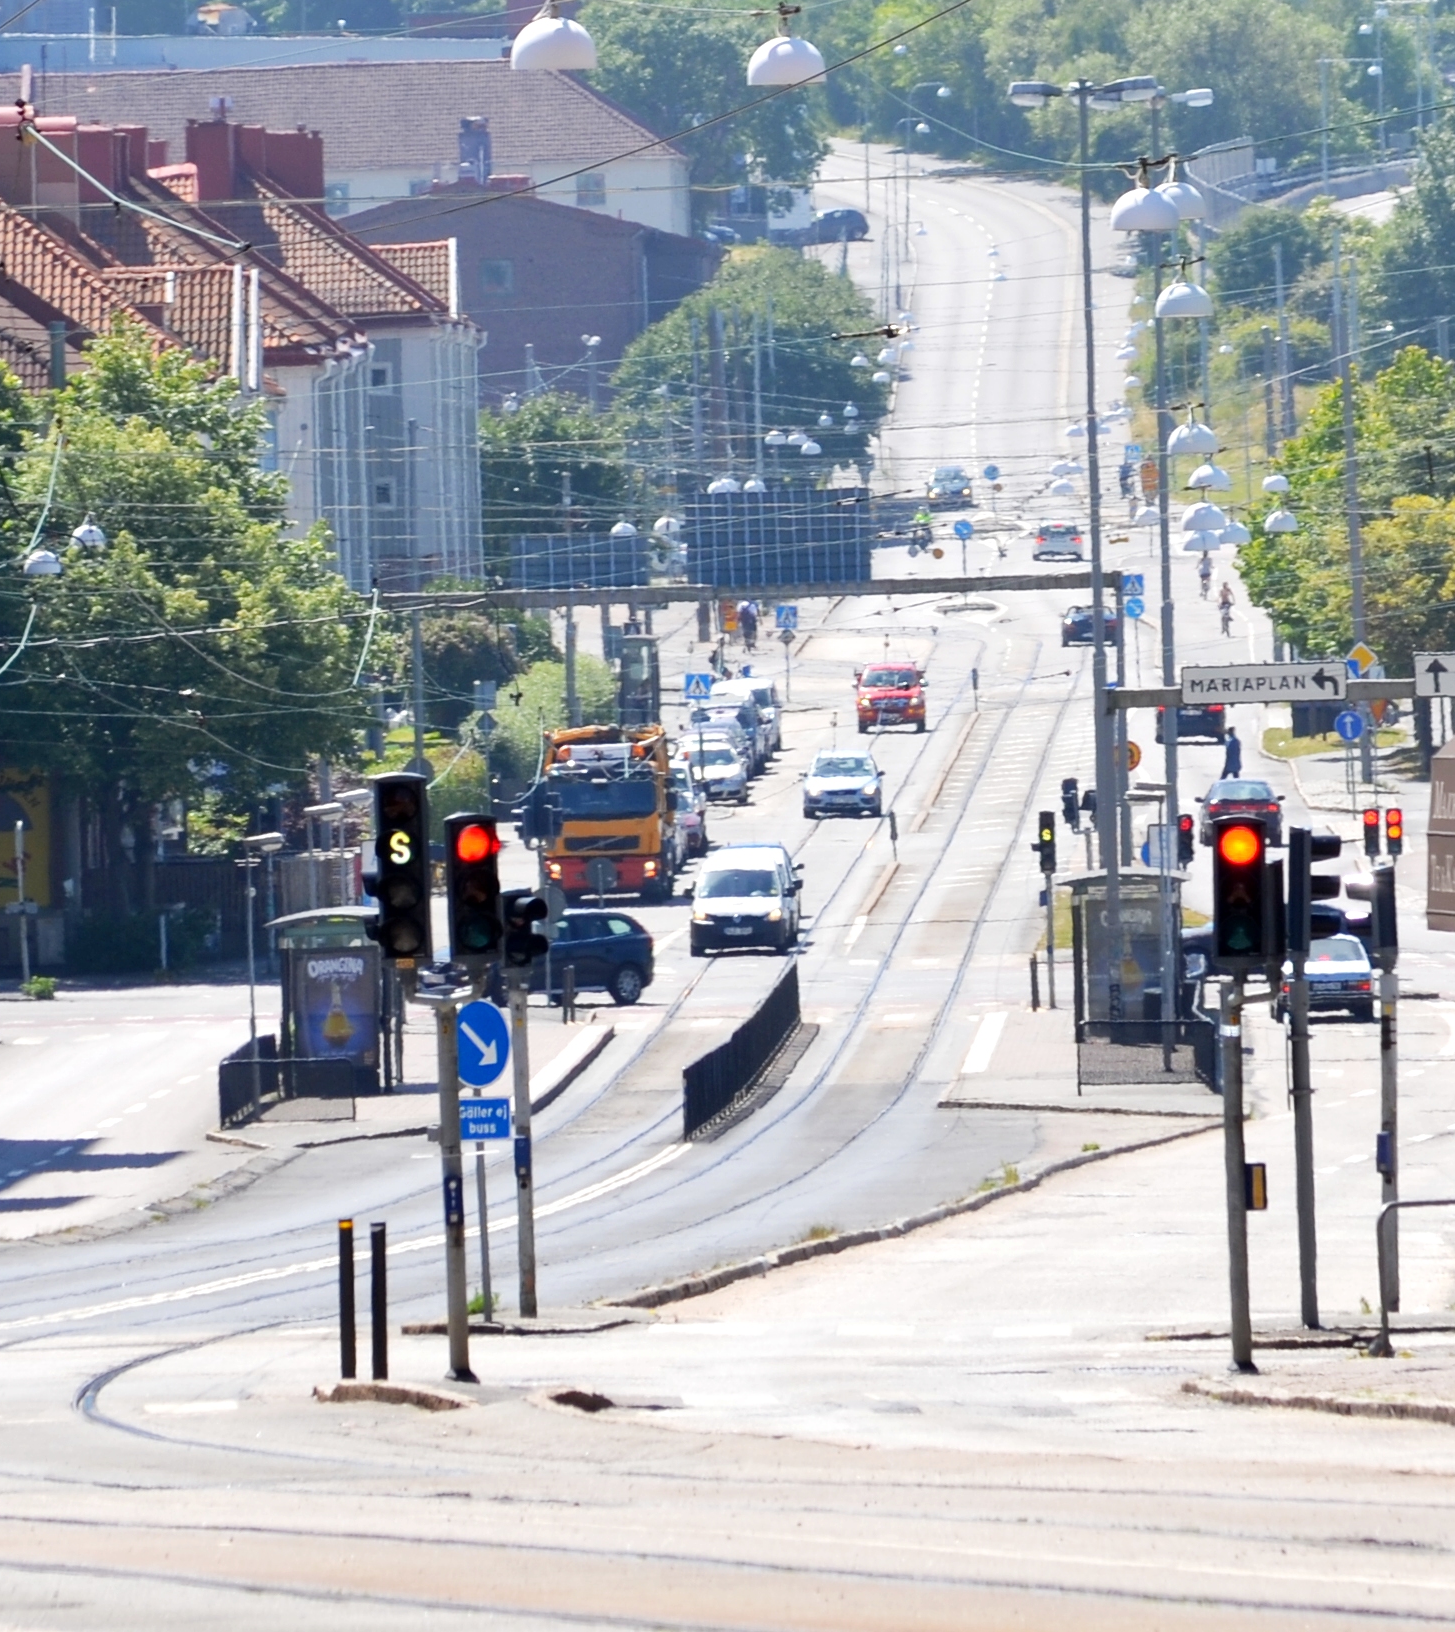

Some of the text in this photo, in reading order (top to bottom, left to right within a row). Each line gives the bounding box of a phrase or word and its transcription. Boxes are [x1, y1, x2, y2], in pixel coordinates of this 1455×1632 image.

[1190, 675, 1307, 693] MARIAPLAN
[307, 957, 364, 979] ORANGINA
[459, 1104, 507, 1120] Gäller ej
[469, 1122, 497, 1134] buss
